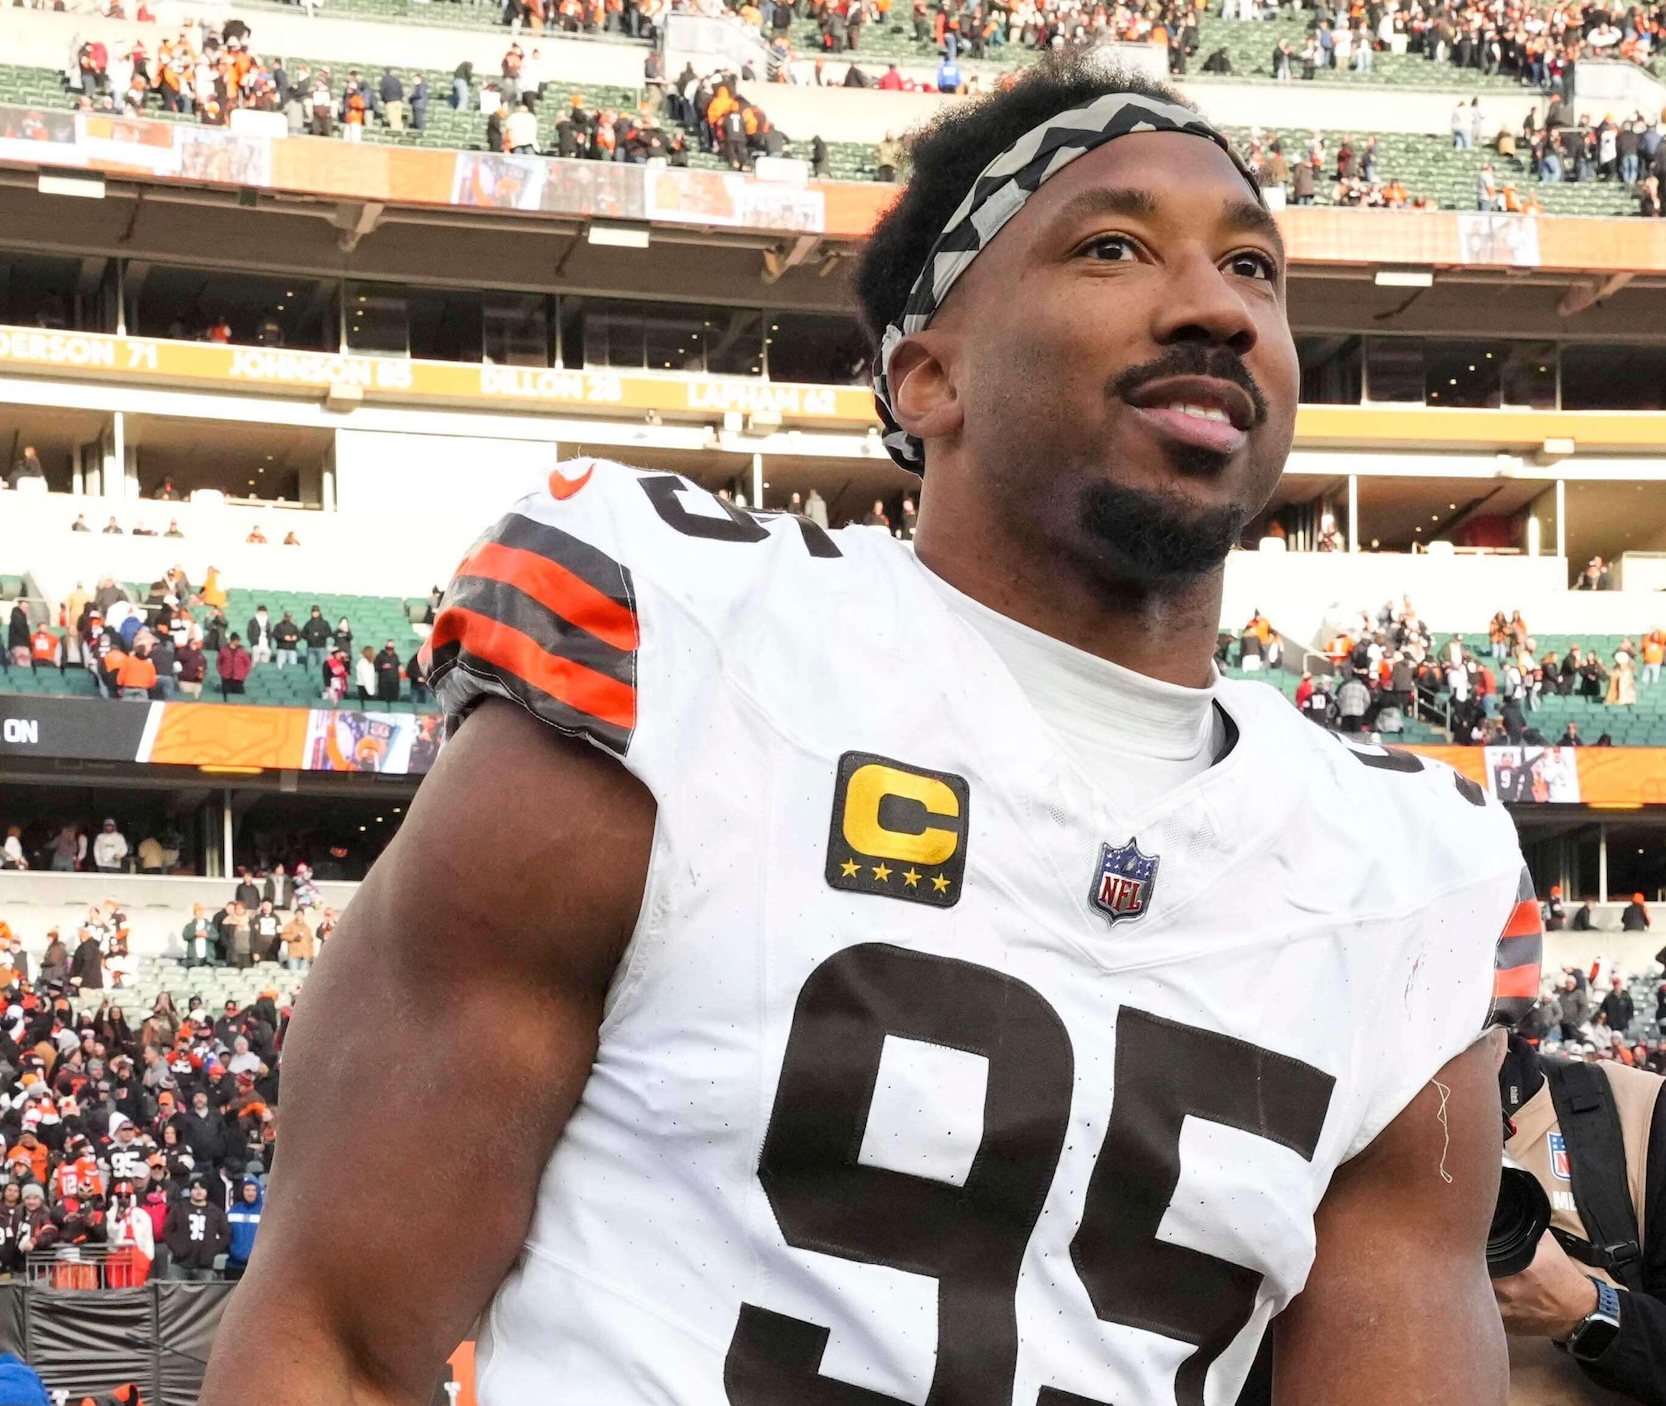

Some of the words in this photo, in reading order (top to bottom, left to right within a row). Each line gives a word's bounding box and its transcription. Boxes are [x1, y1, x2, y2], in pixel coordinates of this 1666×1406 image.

[127, 341, 157, 369] 71
[230, 349, 370, 387] JOHNSON
[2, 716, 38, 743] ON
[843, 763, 959, 865] C
[1099, 876, 1142, 912] NFL
[111, 1152, 140, 1178] 95
